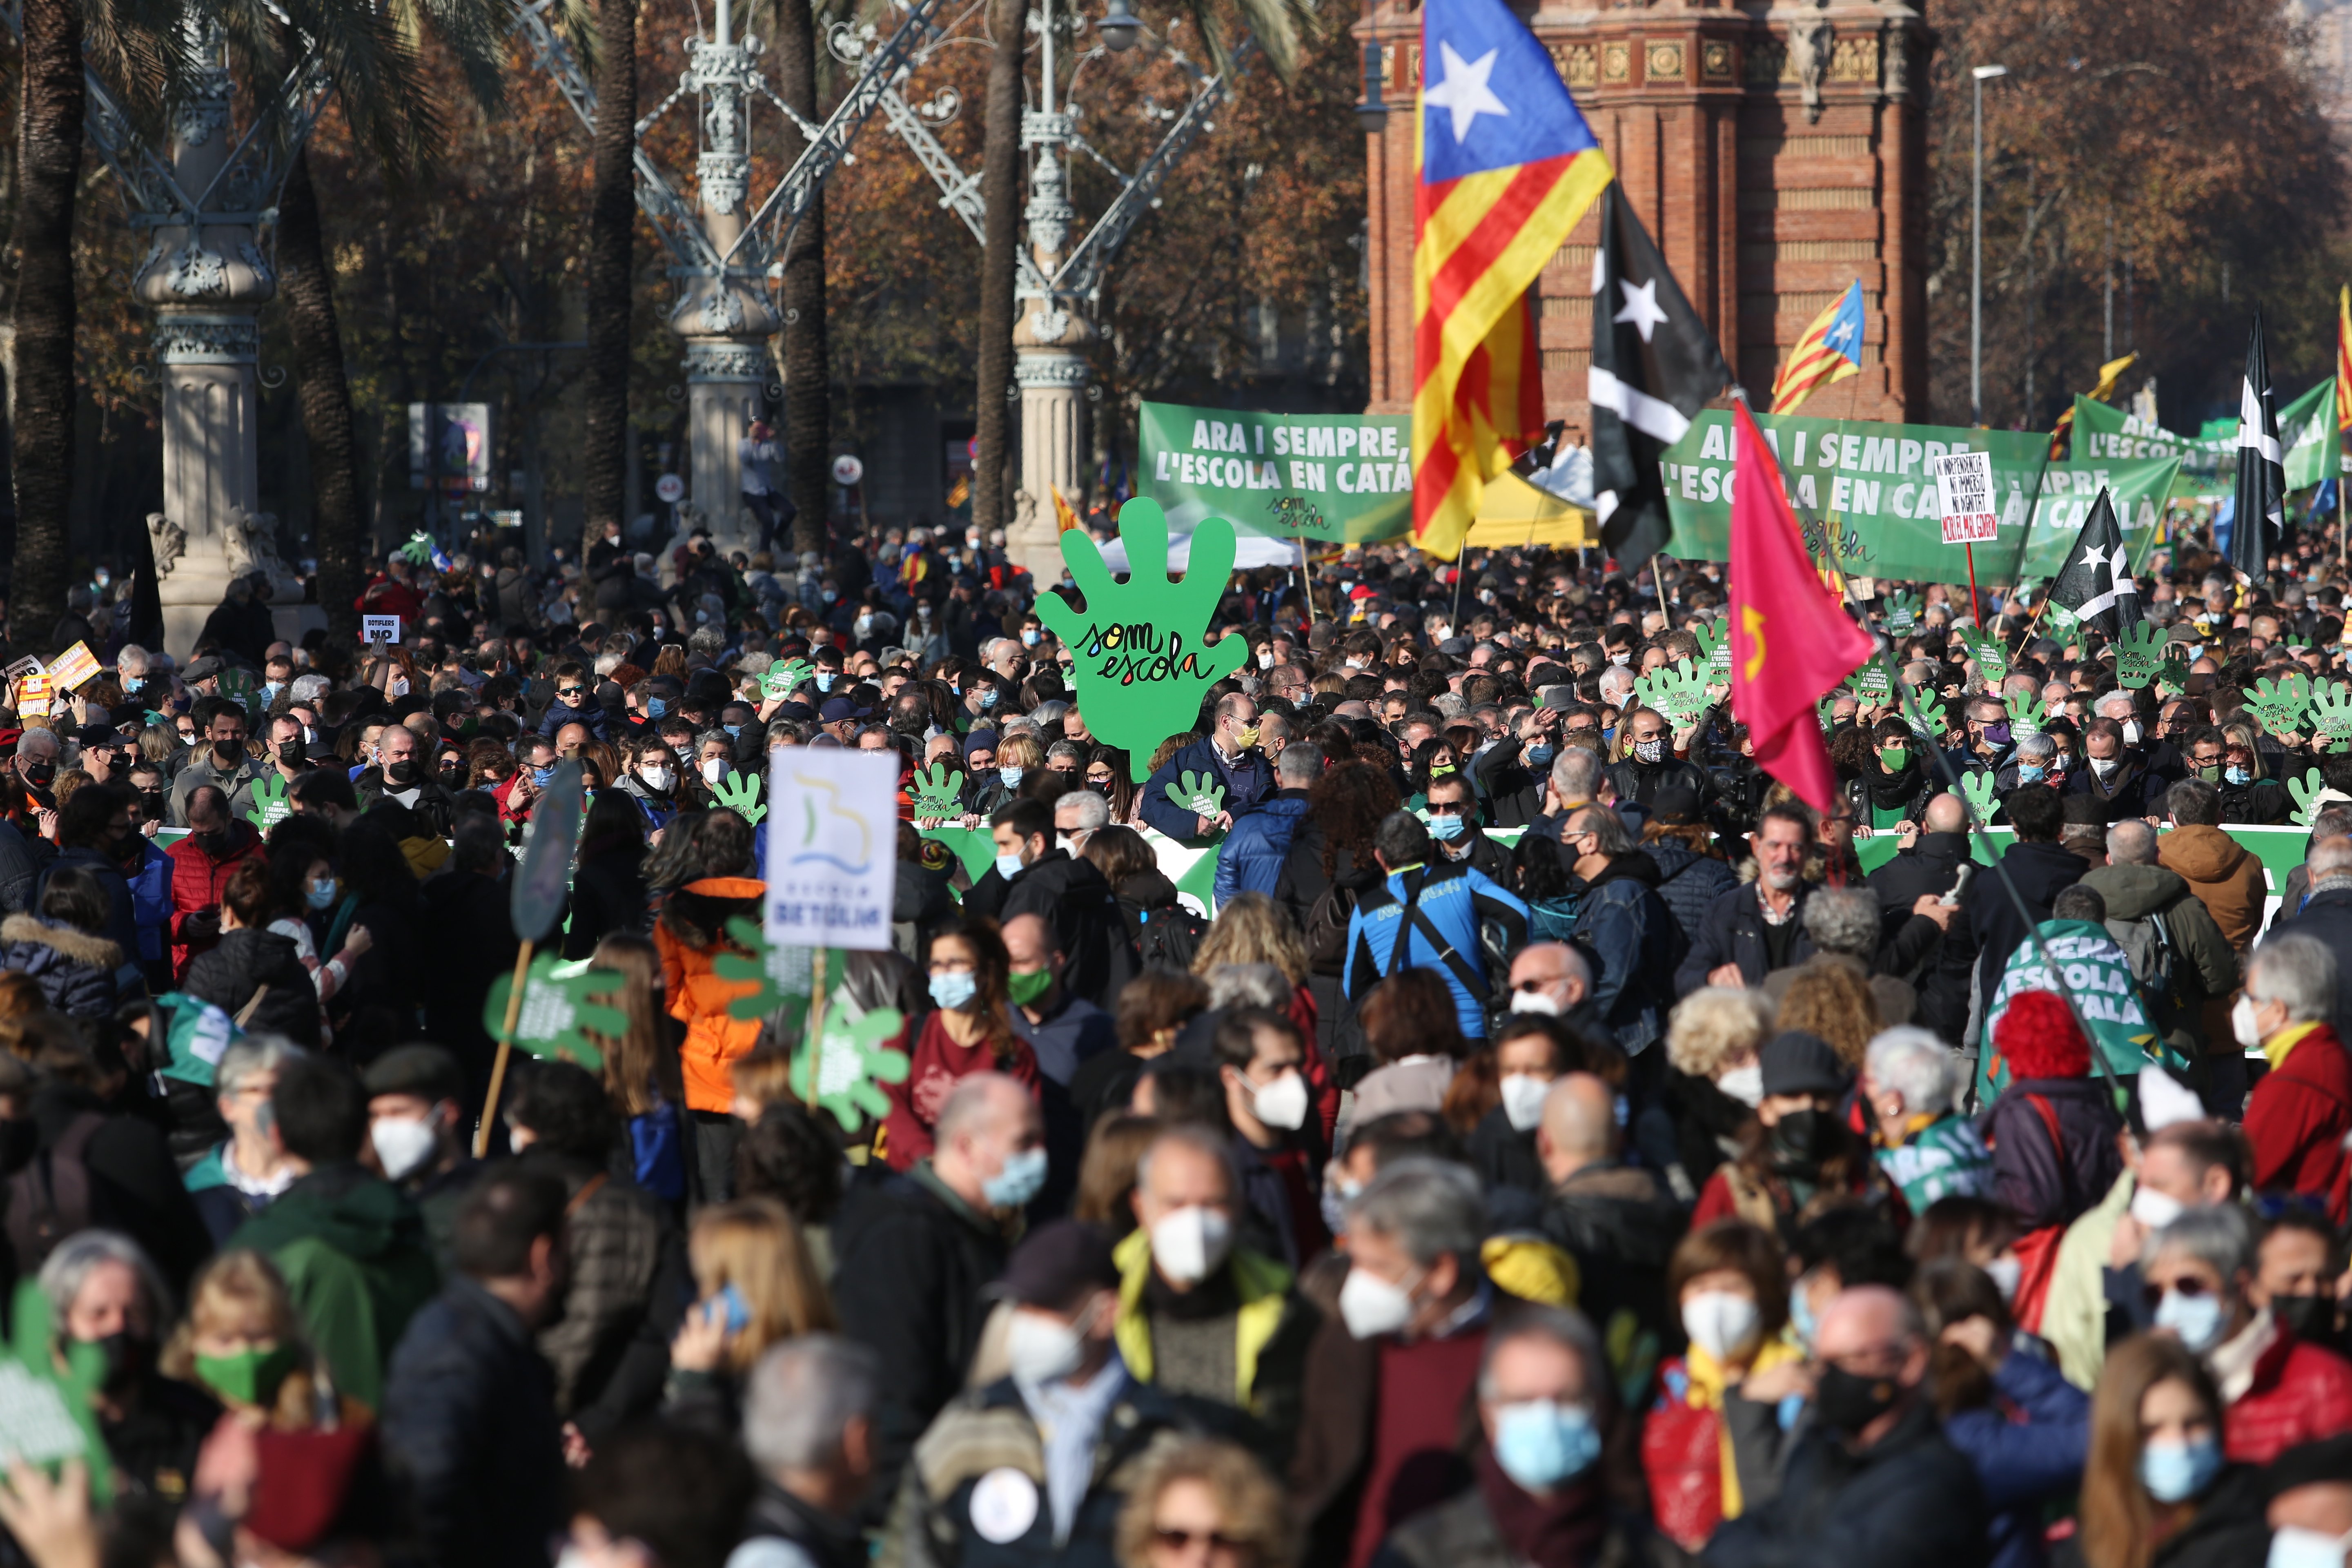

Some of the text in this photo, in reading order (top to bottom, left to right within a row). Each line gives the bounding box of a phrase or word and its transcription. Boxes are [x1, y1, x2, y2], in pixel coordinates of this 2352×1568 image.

[1192, 419, 1410, 462] ARA I SEMPRE,
[1699, 424, 1781, 463] AA
[1793, 431, 1806, 467] I
[1155, 451, 1413, 493] L'ESCOLA EN CATA
[1266, 497, 1308, 514] som
[1831, 476, 1880, 515] EN
[1893, 480, 2024, 526] CAÀ
[1278, 504, 1331, 530] escola
[2049, 493, 2156, 530] CALÀ
[1963, 514, 1976, 539] MAL
[1976, 513, 1996, 539] GOVERN
[370, 630, 392, 639] NO
[1074, 622, 1163, 658] som
[49, 646, 84, 676] EXIGIM
[1096, 630, 1216, 686] escola
[2119, 650, 2141, 660] som
[2123, 655, 2153, 668] escola
[7, 659, 33, 674] BOTIFLERS
[14, 666, 38, 678] NO
[66, 665, 77, 674] LA
[27, 677, 42, 693] HEM
[1668, 690, 1690, 701] som
[1674, 692, 1703, 707] escola
[19, 699, 48, 715] GUANYAT
[2256, 703, 2279, 714] som
[2265, 704, 2294, 717] escola
[1909, 721, 1927, 734] L'ESCOL
[2317, 716, 2341, 726] som
[915, 795, 938, 804] som
[920, 798, 951, 811] escola
[1192, 797, 1213, 808] SEMPRE,
